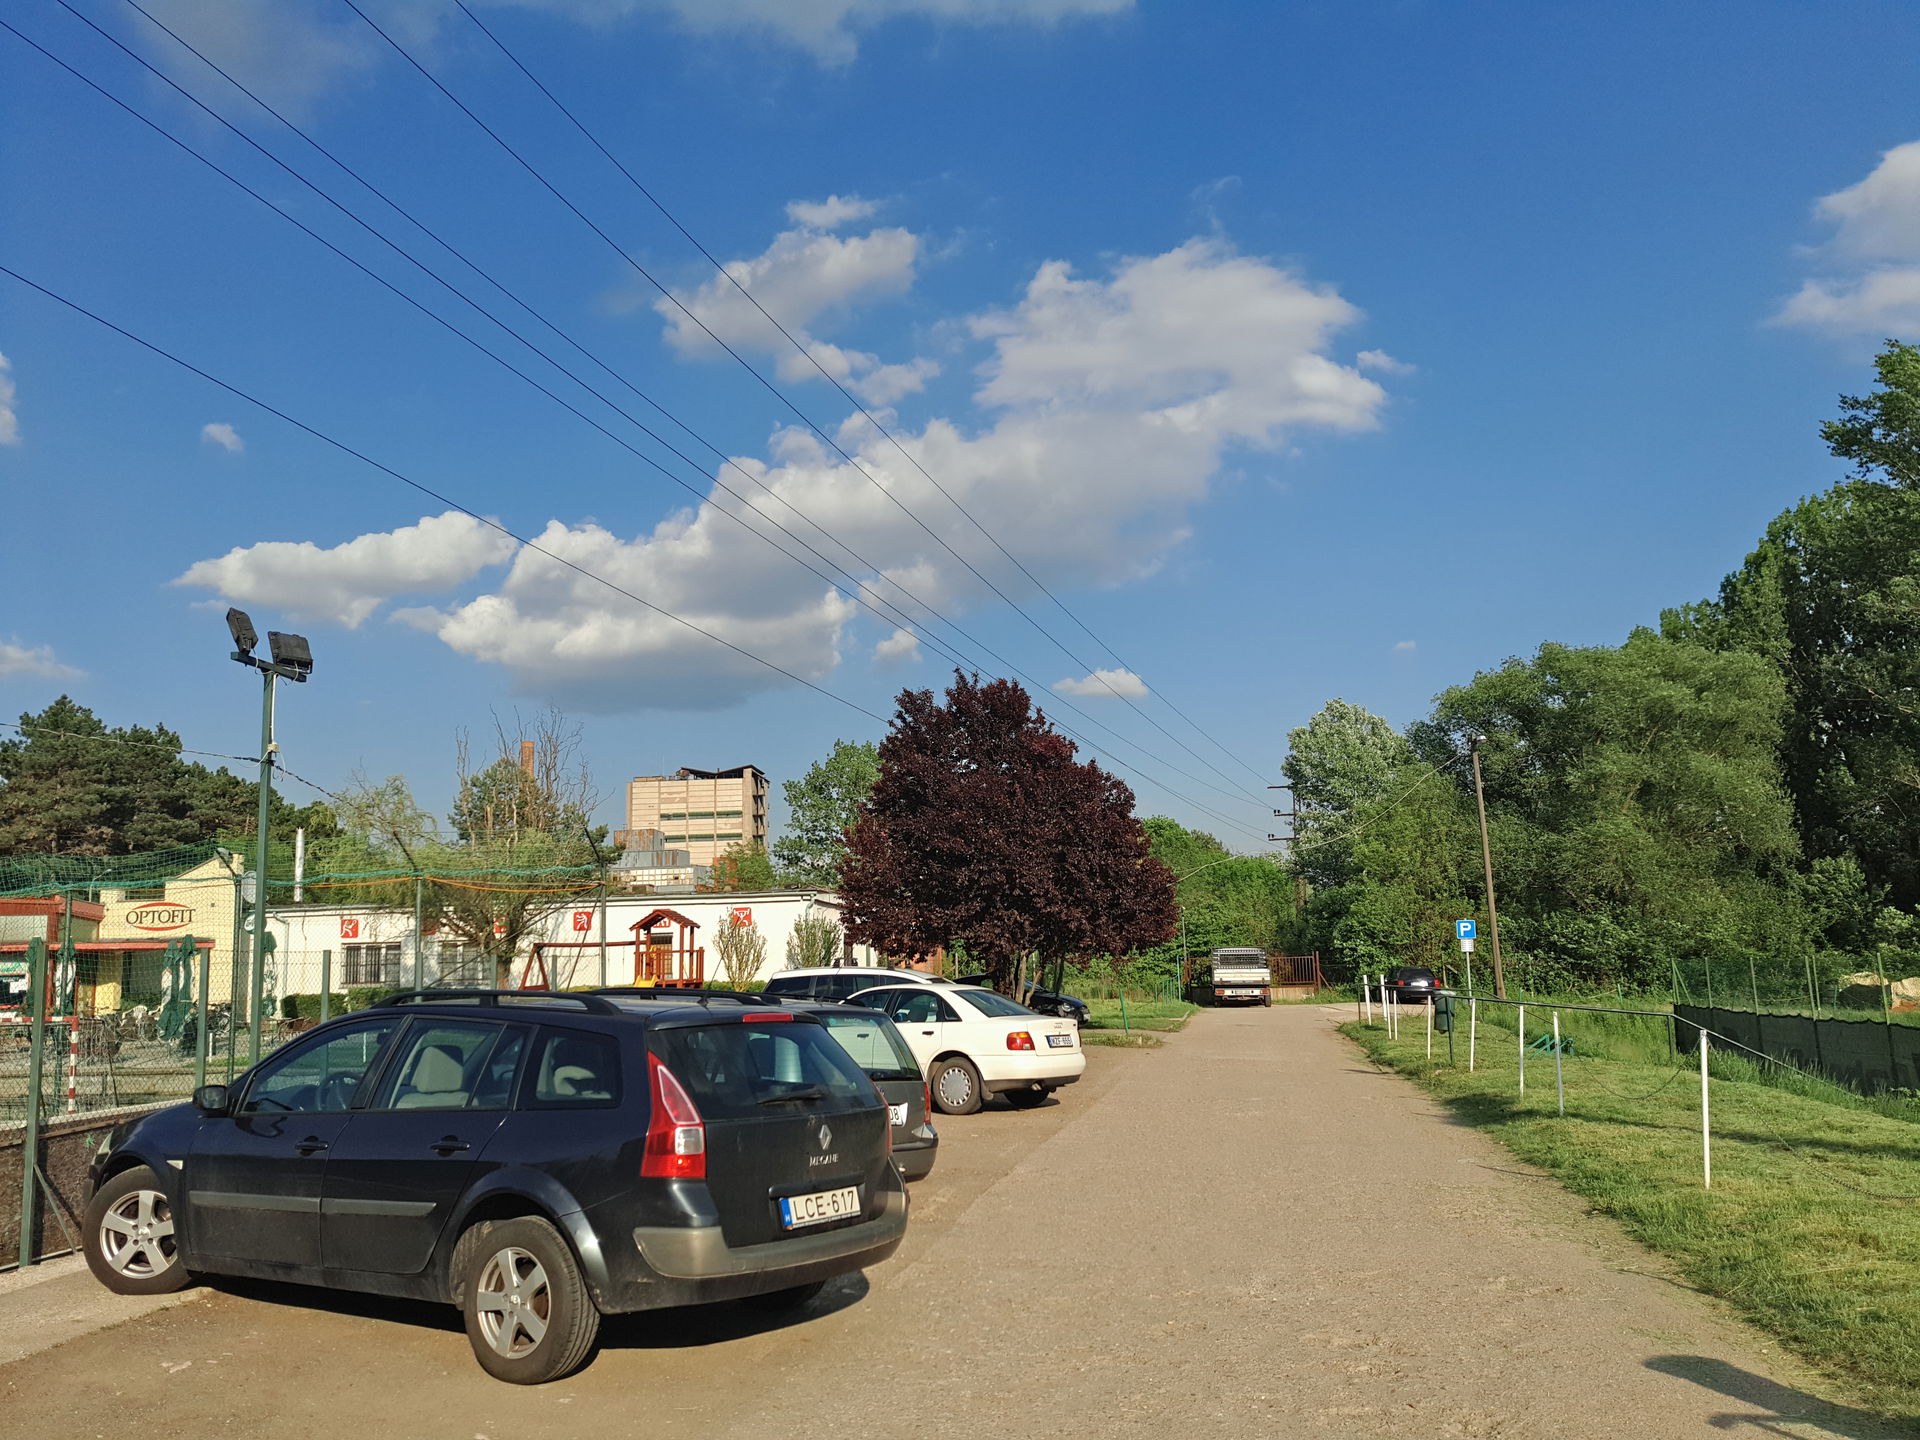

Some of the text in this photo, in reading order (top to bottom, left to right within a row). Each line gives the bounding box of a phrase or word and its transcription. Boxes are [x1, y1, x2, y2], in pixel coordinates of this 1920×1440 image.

[126, 909, 196, 924] OPTOFIT
[1460, 923, 1471, 936] P
[793, 1190, 854, 1220] LCE-617
